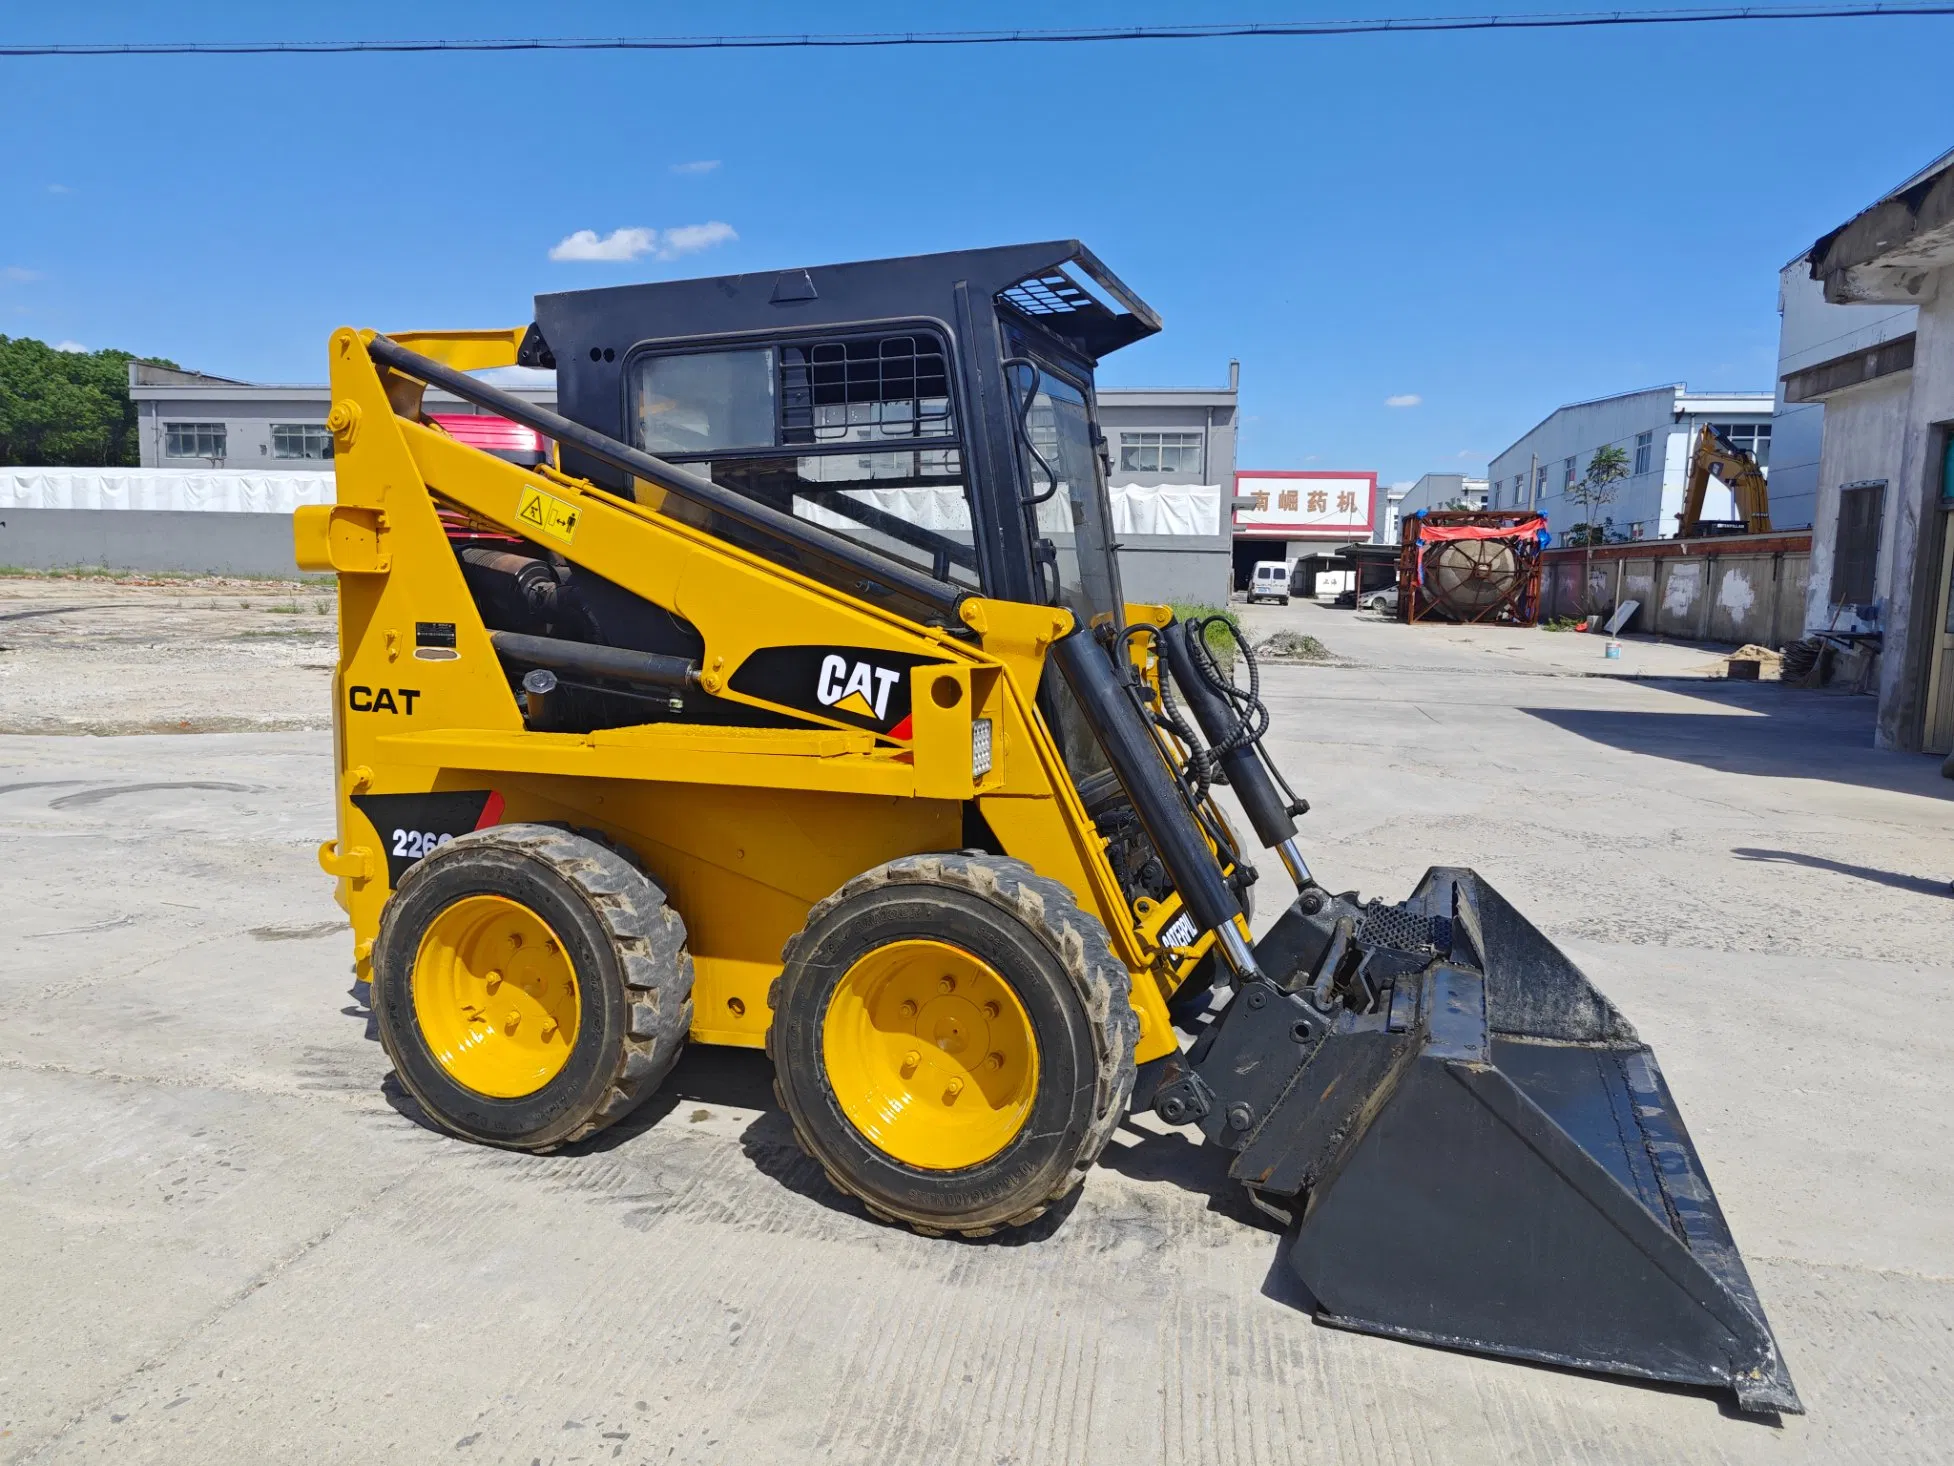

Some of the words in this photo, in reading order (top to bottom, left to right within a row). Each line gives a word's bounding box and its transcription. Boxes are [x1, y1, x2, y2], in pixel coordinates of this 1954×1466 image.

[349, 685, 421, 716] CAT
[816, 654, 901, 721] CAT
[1161, 909, 1199, 960] CATERPIL
